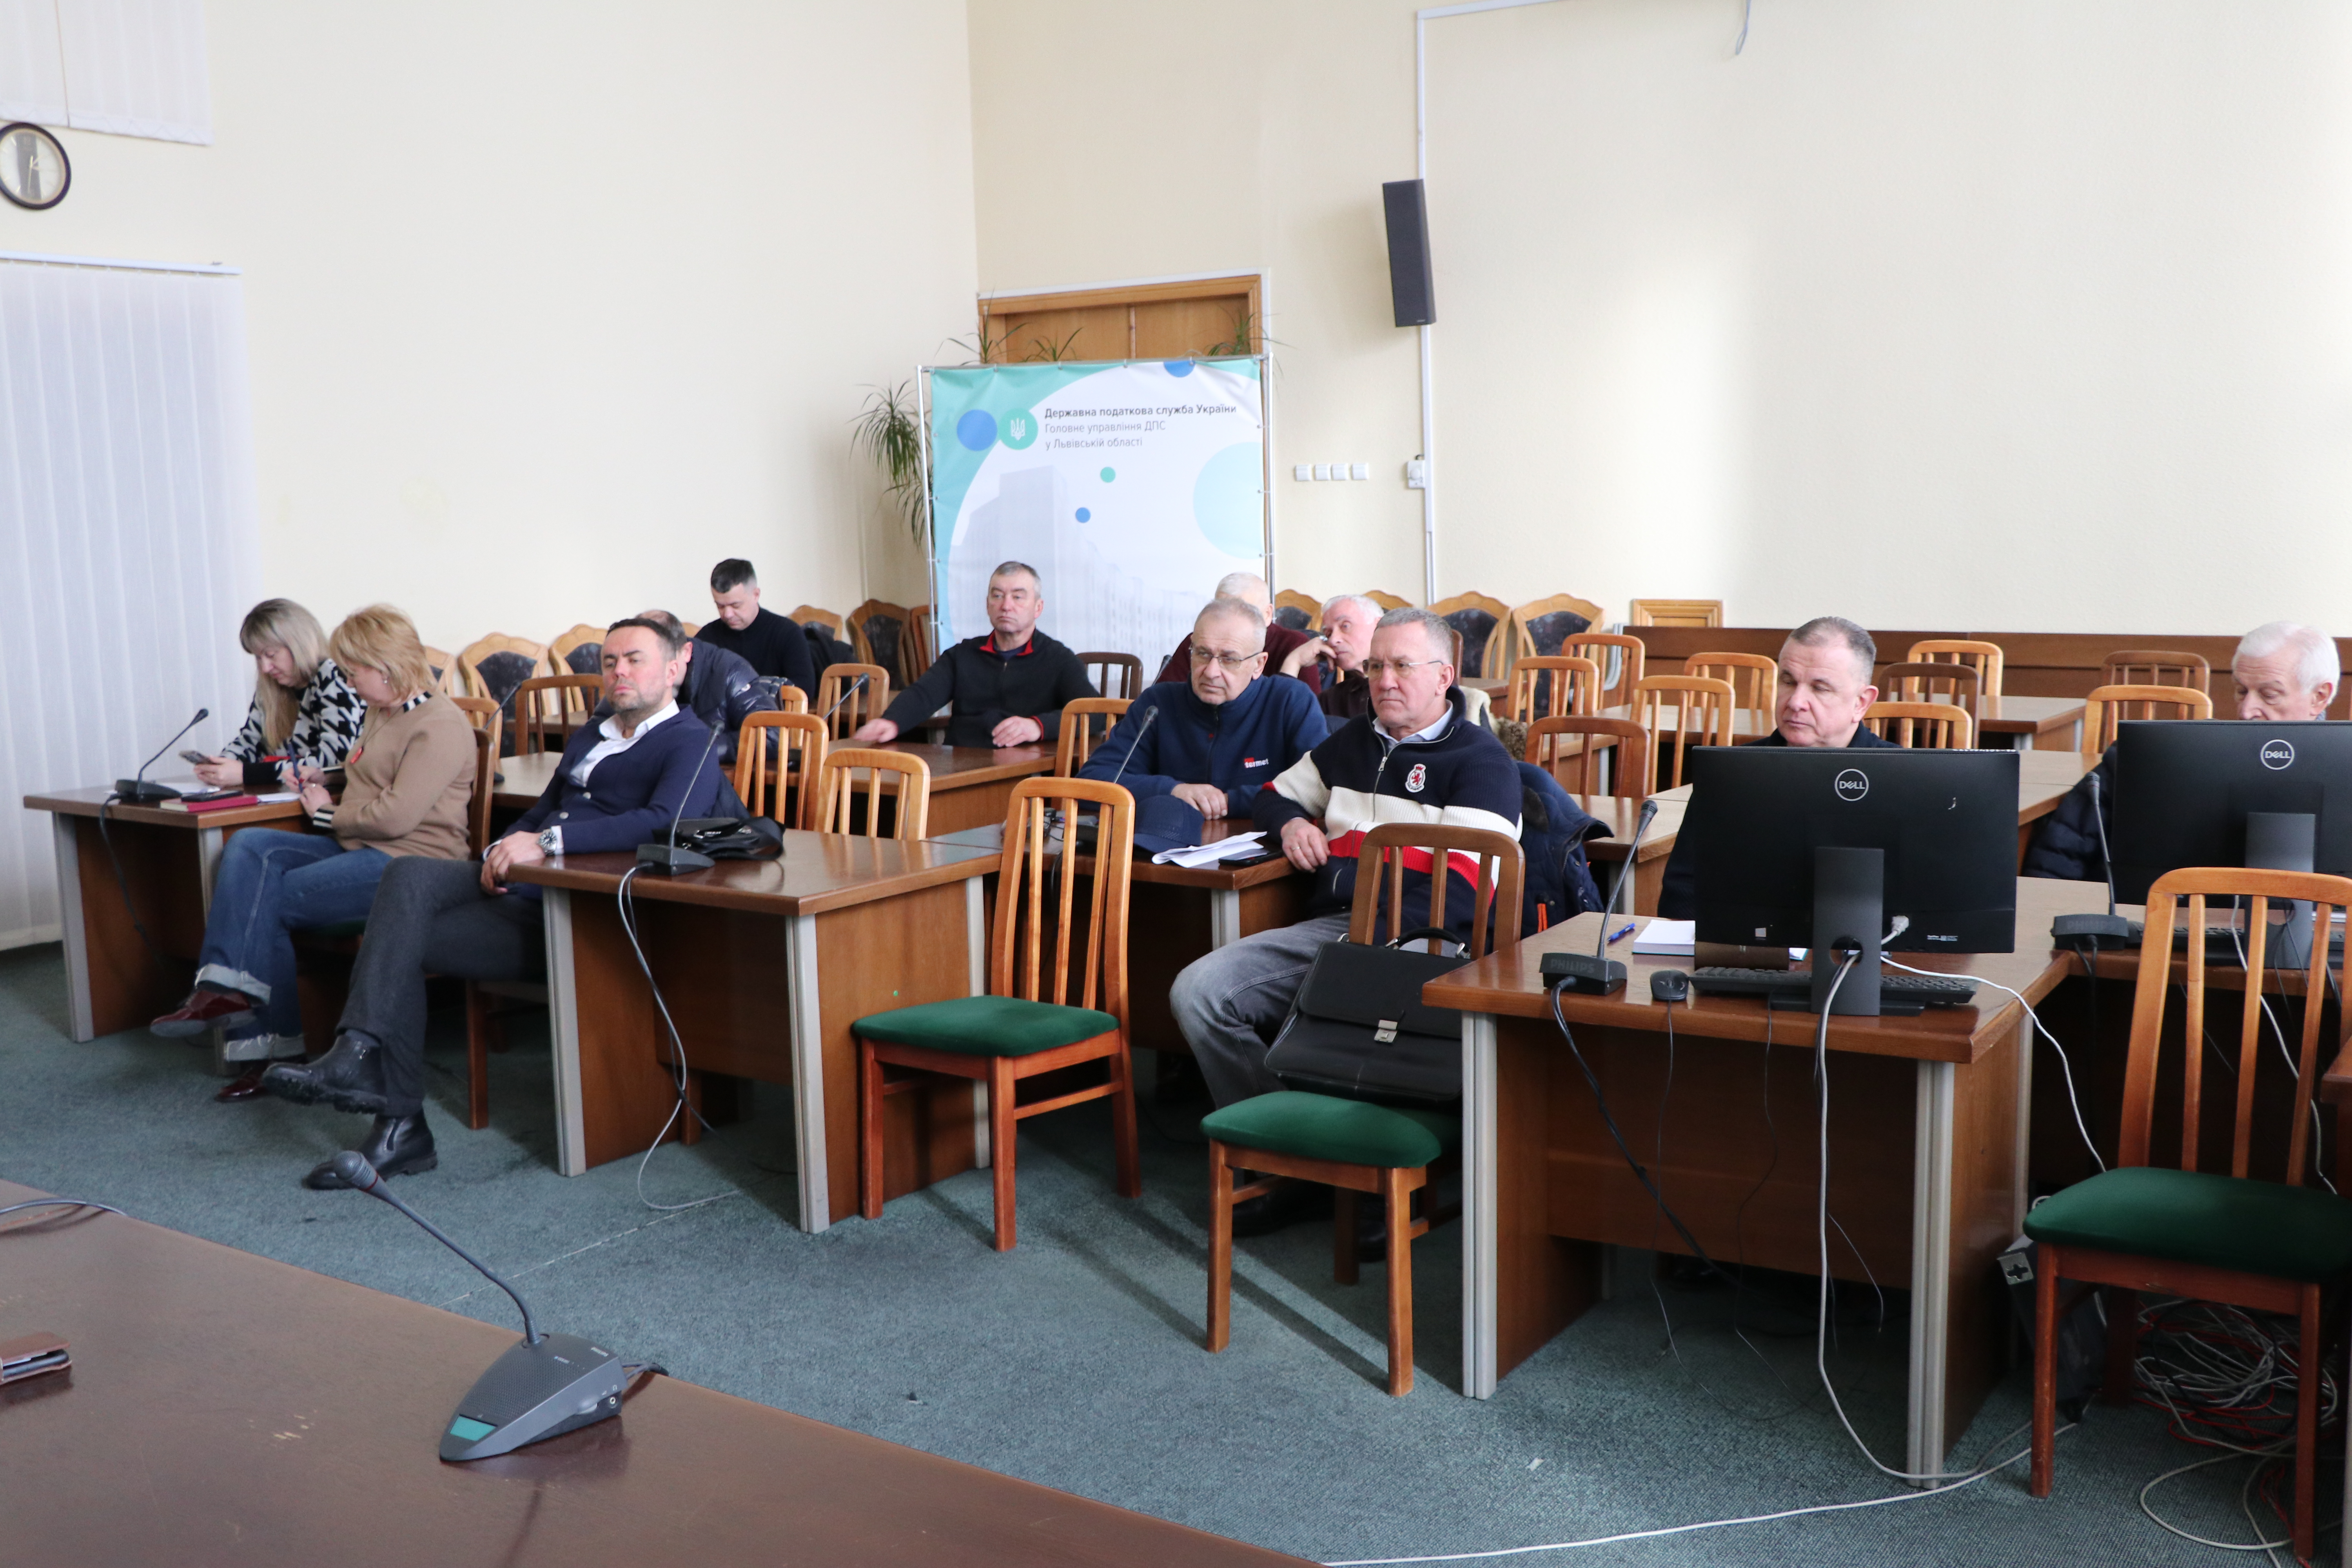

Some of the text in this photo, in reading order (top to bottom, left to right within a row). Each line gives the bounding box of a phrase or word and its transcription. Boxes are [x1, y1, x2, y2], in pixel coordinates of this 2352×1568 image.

[1045, 404, 1236, 419] Державна податкова служба України
[1045, 421, 1166, 434] Головне управління ДПС
[1045, 437, 1142, 451] у Львівській області
[1245, 758, 1269, 768] termet
[1839, 781, 1866, 789] DELL
[1550, 959, 1595, 973] PHILIPS
